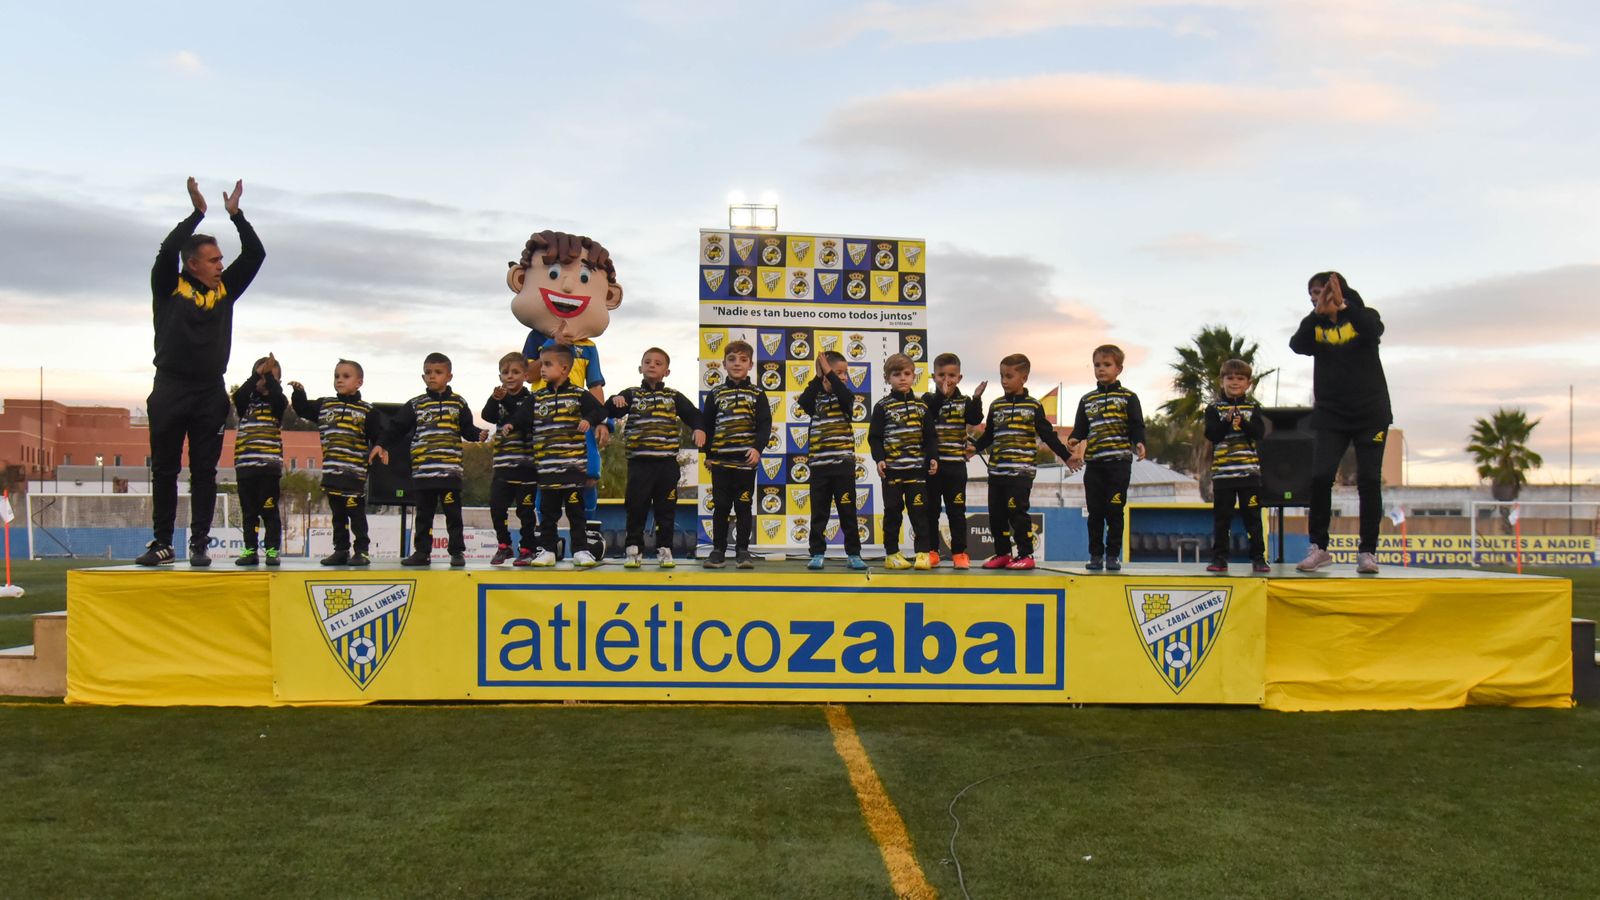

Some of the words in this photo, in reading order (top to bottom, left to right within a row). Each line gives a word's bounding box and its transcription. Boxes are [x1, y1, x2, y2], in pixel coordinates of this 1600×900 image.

[713, 306, 748, 316] "Nadie
[751, 308, 761, 316] es
[763, 308, 781, 317] tan
[783, 307, 816, 318] bueno
[818, 311, 846, 319] como
[849, 310, 878, 320] todos
[880, 311, 917, 322] juntos"
[970, 527, 992, 535] FILIA
[1418, 538, 1427, 548] Y
[1432, 538, 1453, 548] NO
[1458, 538, 1529, 549] INSULTES
[1533, 539, 1543, 548] A
[1548, 539, 1591, 549] NADIE
[1329, 552, 1411, 564] QUEMOS
[1480, 552, 1506, 563] SIN
[1510, 553, 1592, 564] VIOLENCIA
[330, 617, 348, 632] ATL.
[350, 605, 375, 622] ZABAL
[374, 588, 407, 610] LINENSE
[1147, 623, 1165, 636] ATL.
[1166, 610, 1190, 627] ZABAL
[1192, 595, 1223, 615] LINENSE
[499, 600, 1045, 674] atléticozabal
